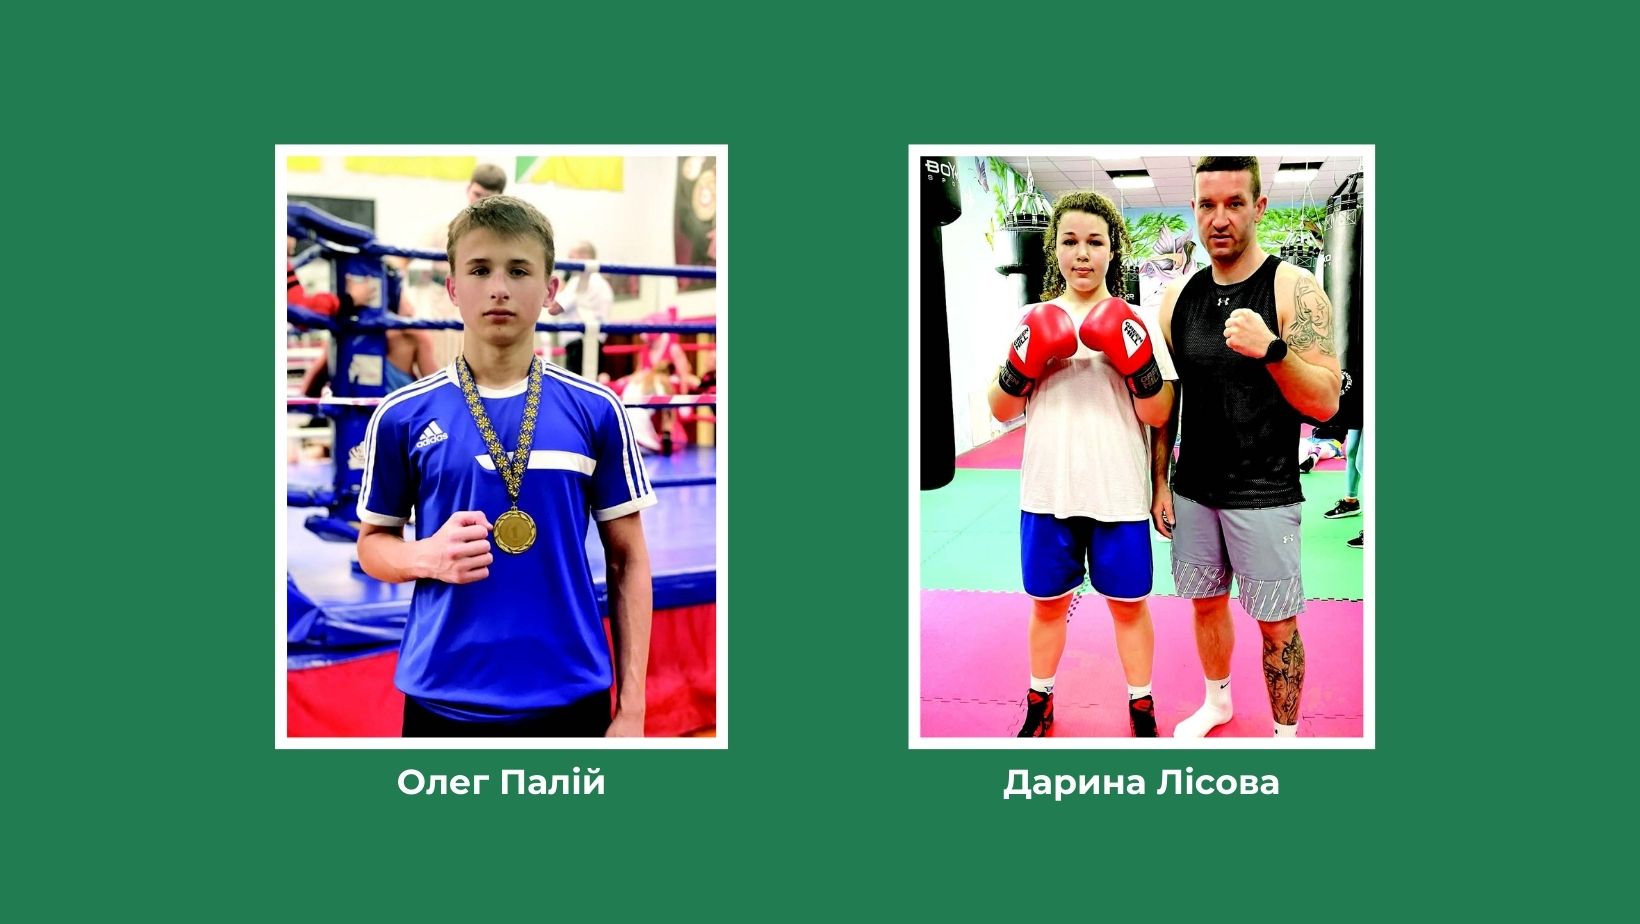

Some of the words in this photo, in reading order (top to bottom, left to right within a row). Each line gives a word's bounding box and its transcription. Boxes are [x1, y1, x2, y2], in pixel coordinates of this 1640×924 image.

[1123, 326, 1138, 346] HILL
[1125, 321, 1144, 343] GREEN
[1015, 335, 1029, 351] HILL
[416, 432, 448, 448] adidas
